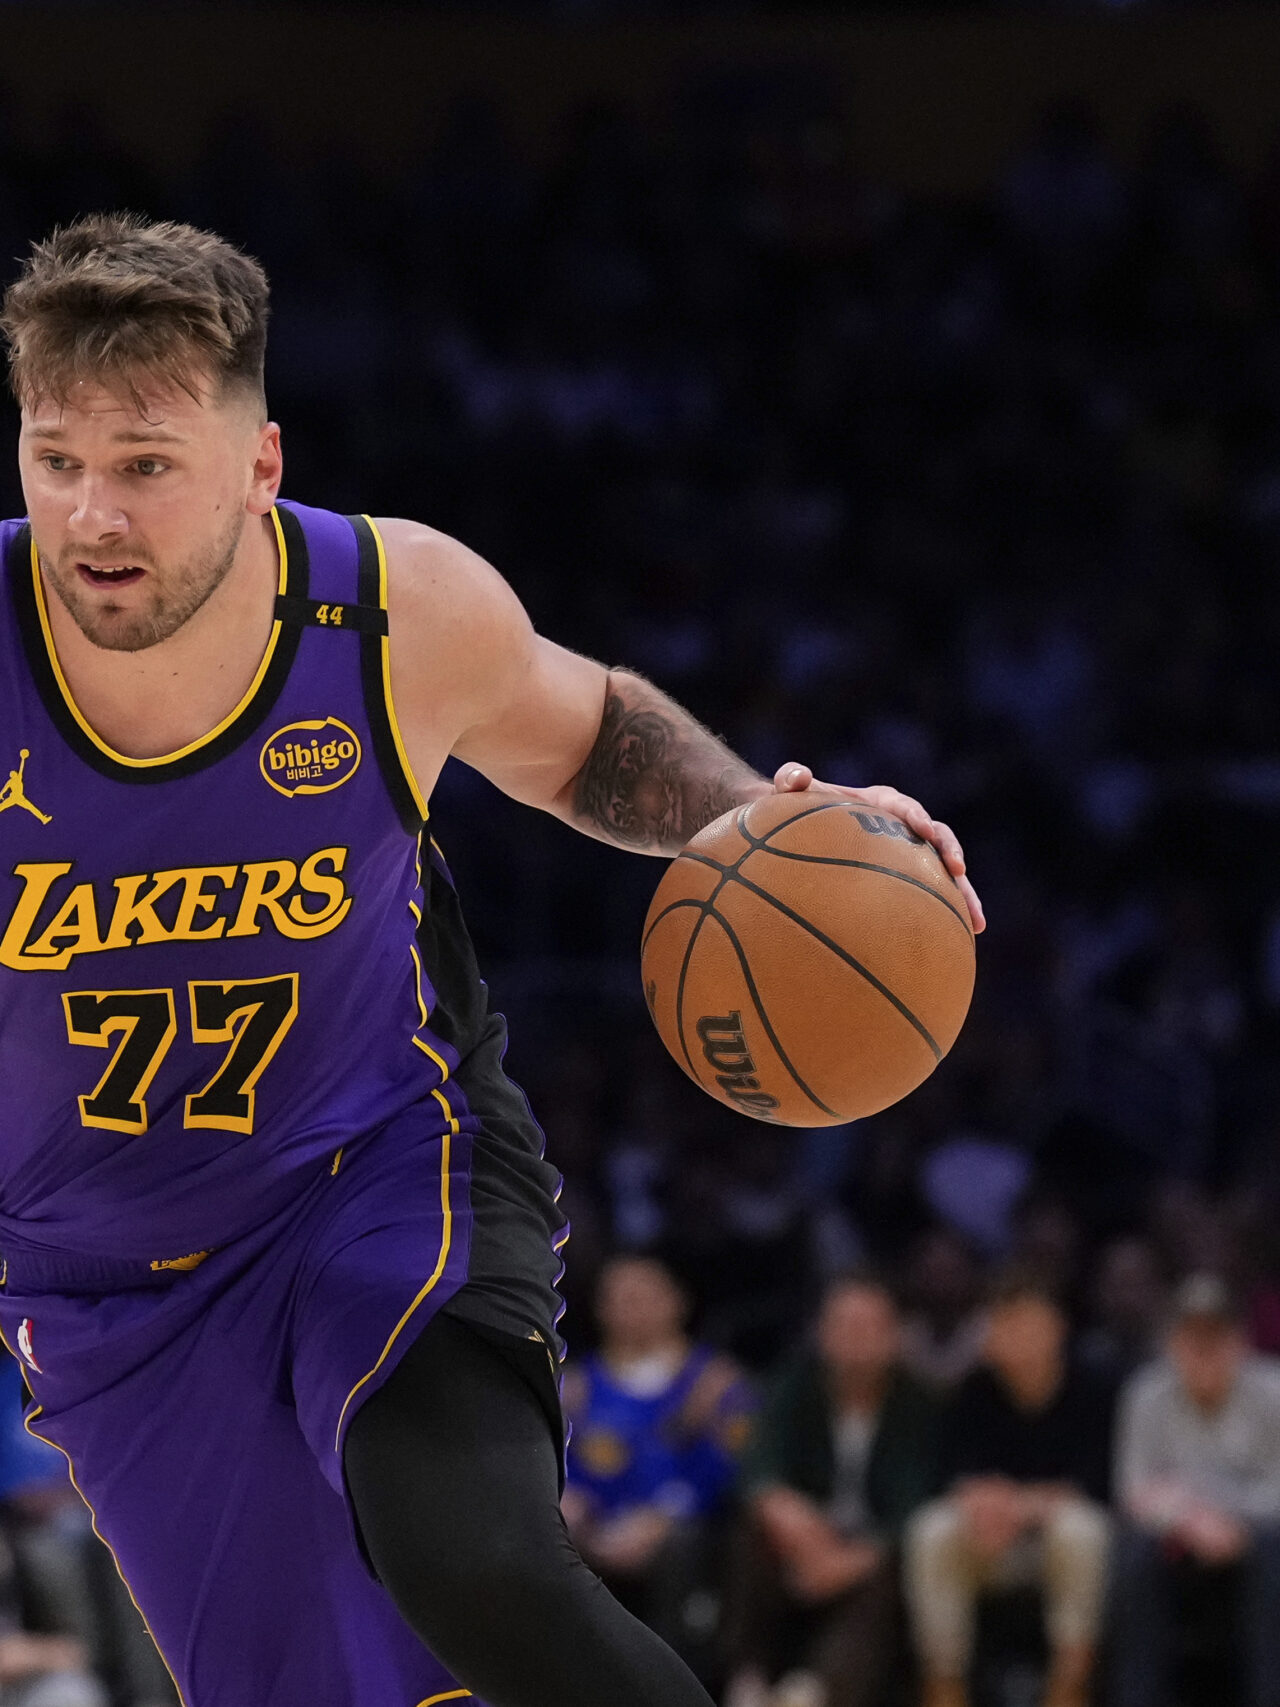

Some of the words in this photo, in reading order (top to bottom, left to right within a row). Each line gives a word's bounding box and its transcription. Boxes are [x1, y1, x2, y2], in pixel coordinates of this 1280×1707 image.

[316, 604, 343, 625] 44
[268, 739, 355, 771] bibigo
[286, 765, 323, 780] 비비고
[60, 972, 300, 1137] 77
